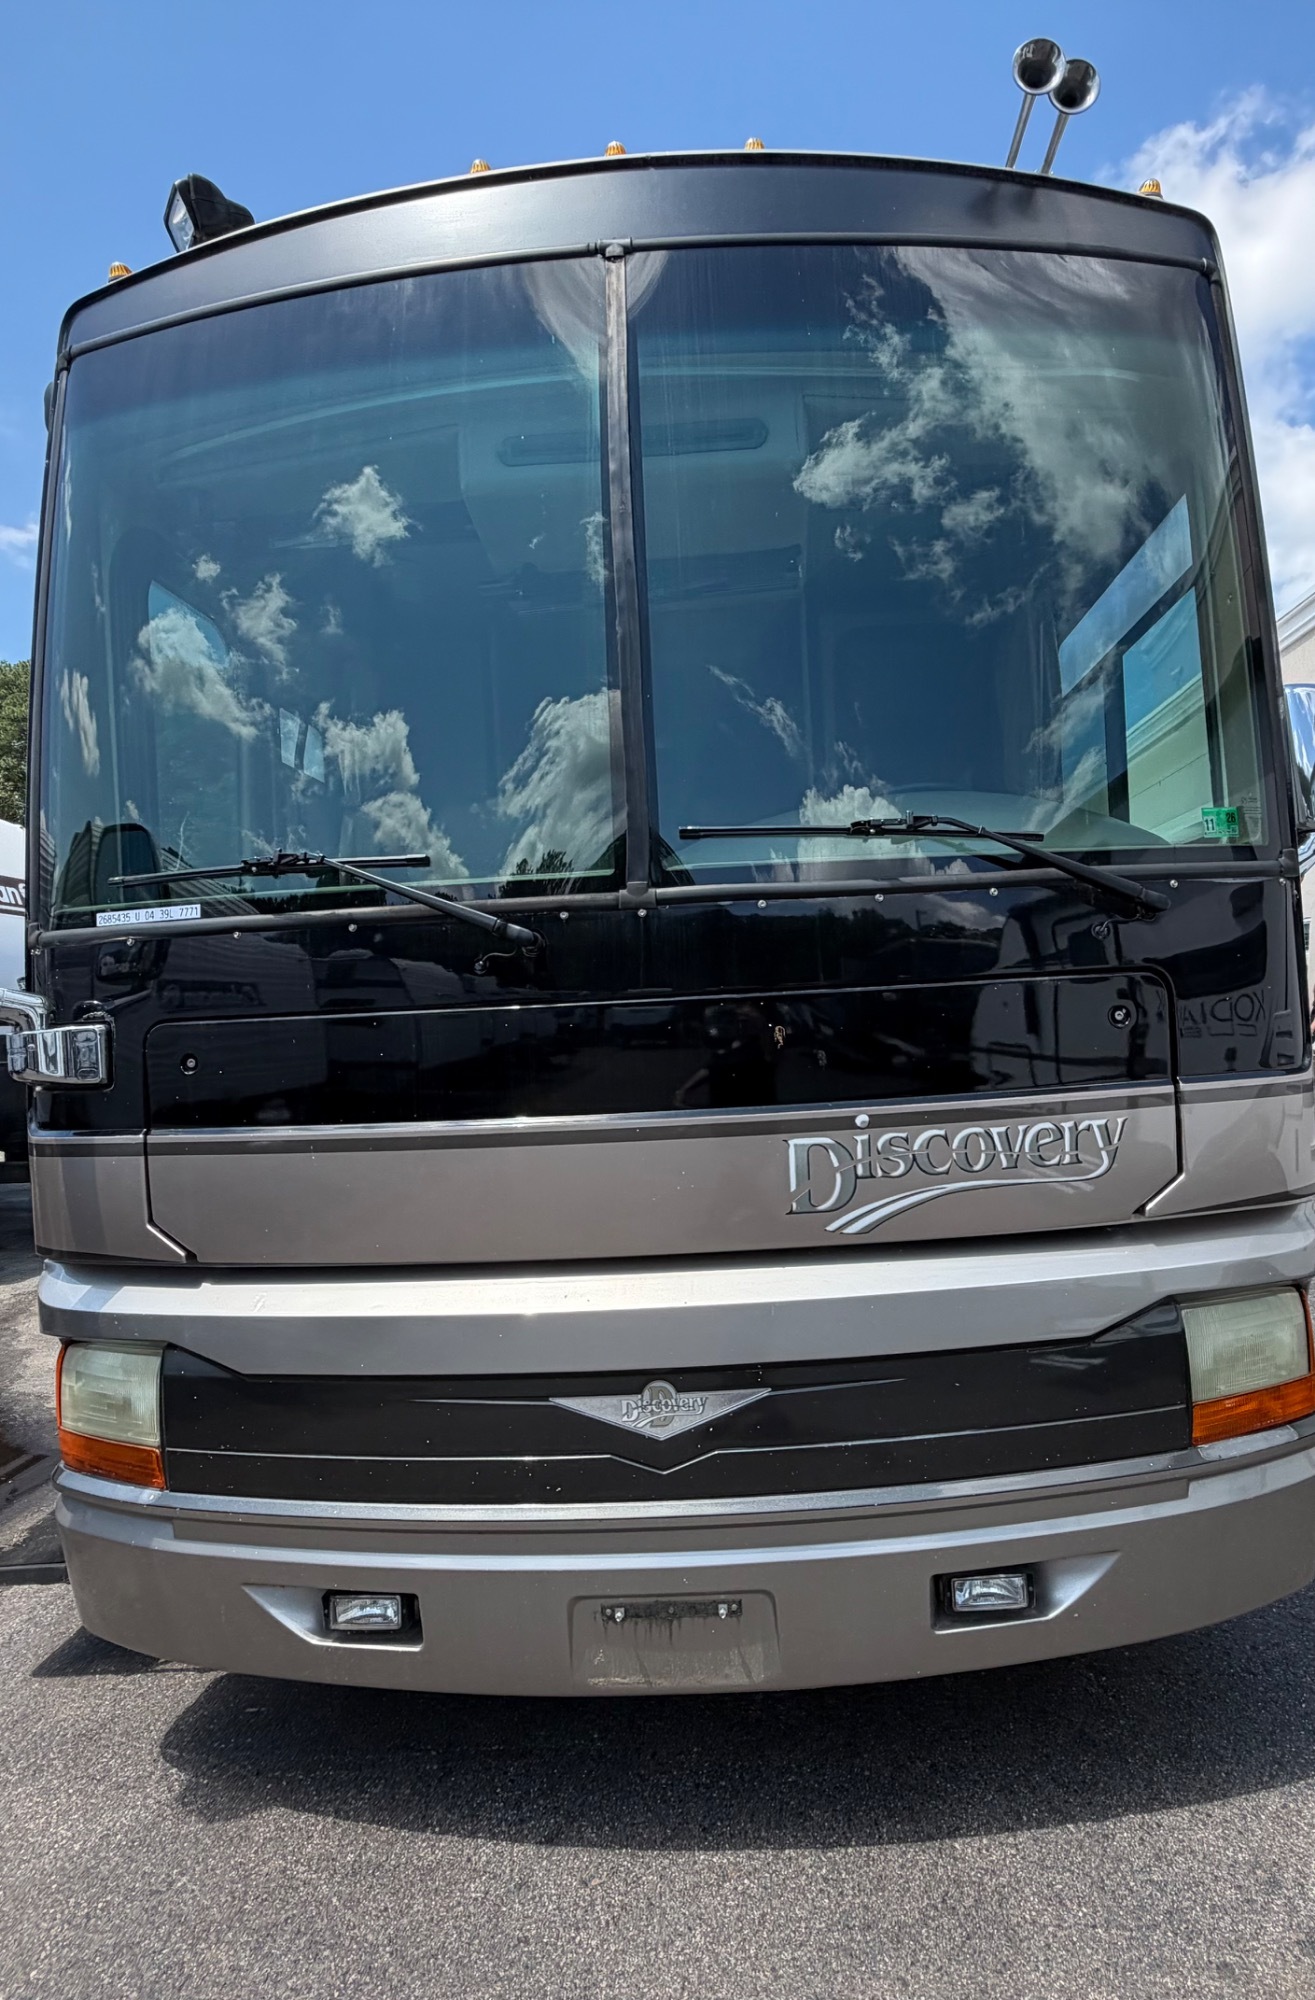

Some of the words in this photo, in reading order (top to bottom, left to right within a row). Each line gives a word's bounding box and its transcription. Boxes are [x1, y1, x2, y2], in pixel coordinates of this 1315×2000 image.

[1204, 818, 1215, 831] 11
[1226, 812, 1236, 824] 26
[98, 912, 131, 925] 2685435
[135, 912, 140, 921] U
[145, 910, 154, 921] 04
[159, 909, 173, 919] 39L
[180, 906, 198, 917] 7771
[783, 1113, 1128, 1216] Discovery
[621, 1394, 707, 1422] Discovery
